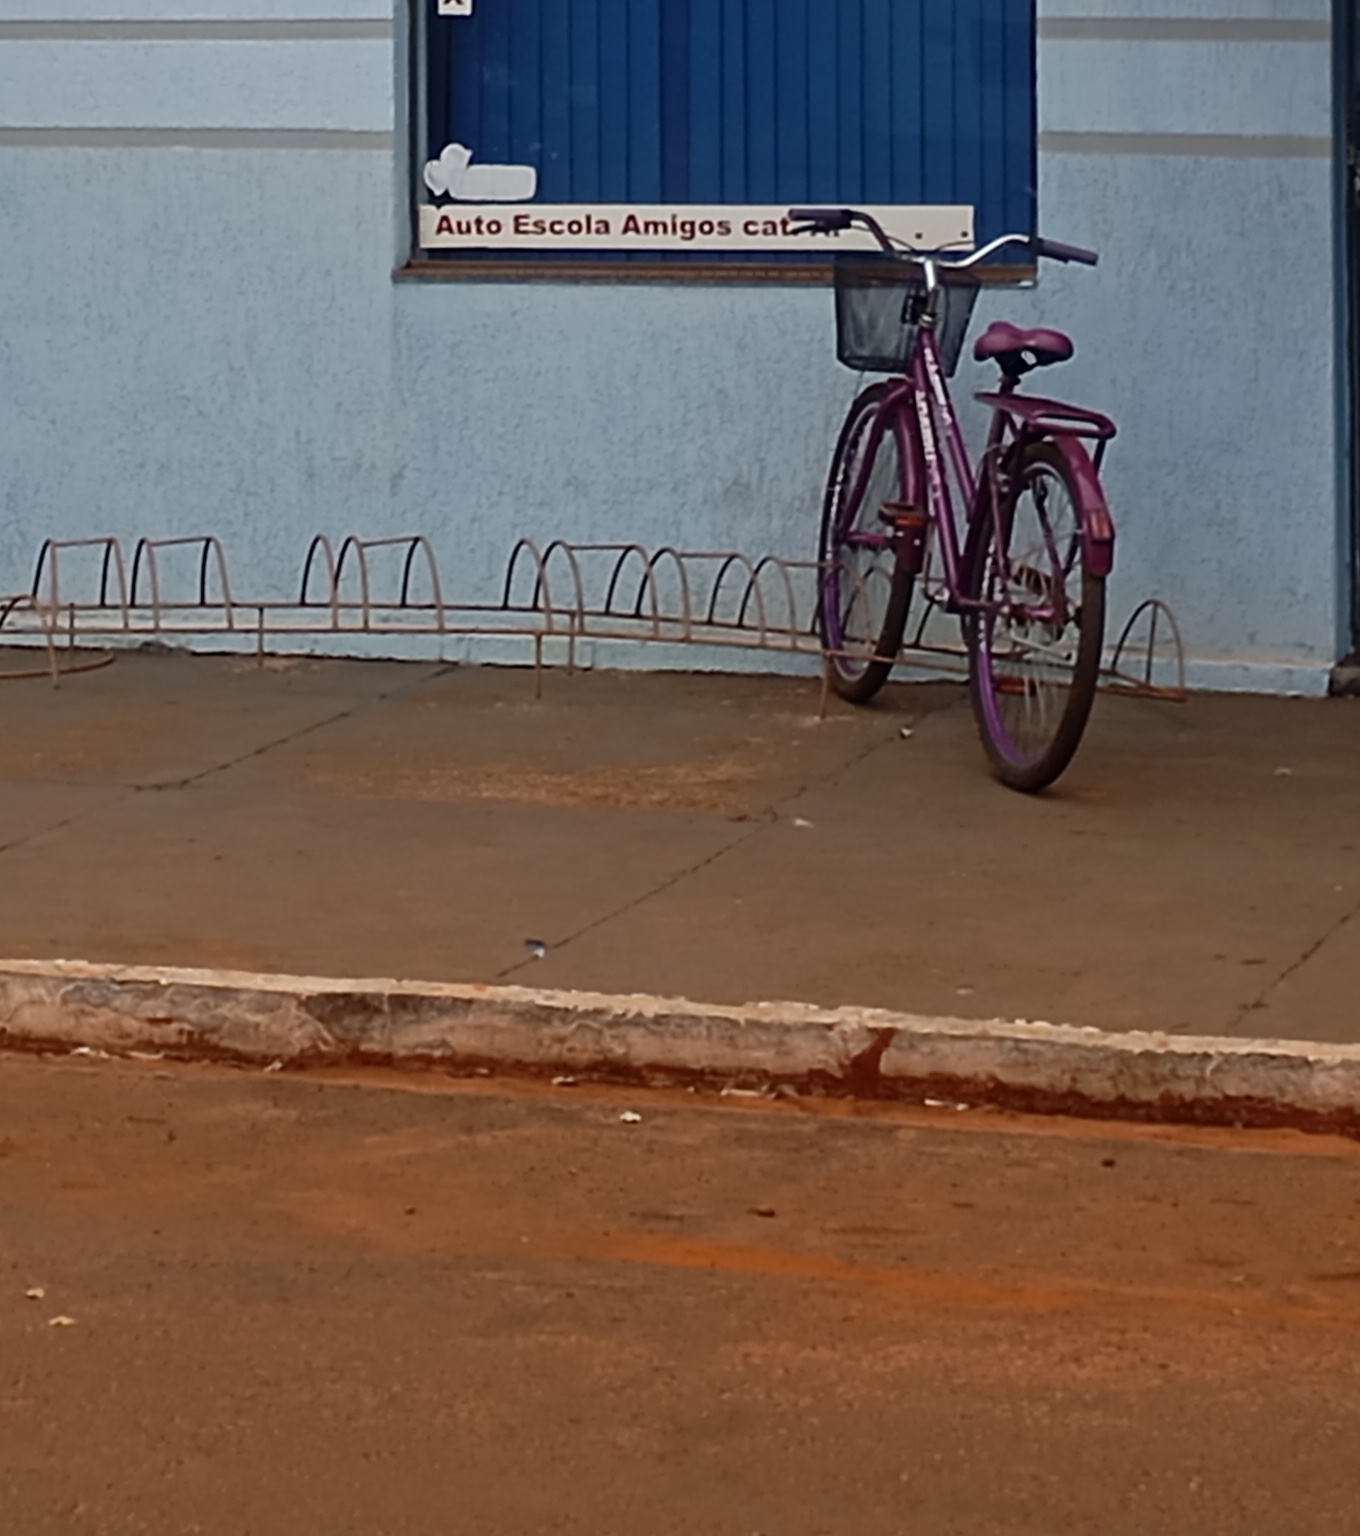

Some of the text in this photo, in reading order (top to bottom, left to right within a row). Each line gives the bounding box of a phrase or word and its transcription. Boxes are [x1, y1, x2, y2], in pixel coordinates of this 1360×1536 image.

[435, 215, 502, 236] Auto
[513, 214, 611, 236] Escola
[621, 214, 732, 240] Amigos
